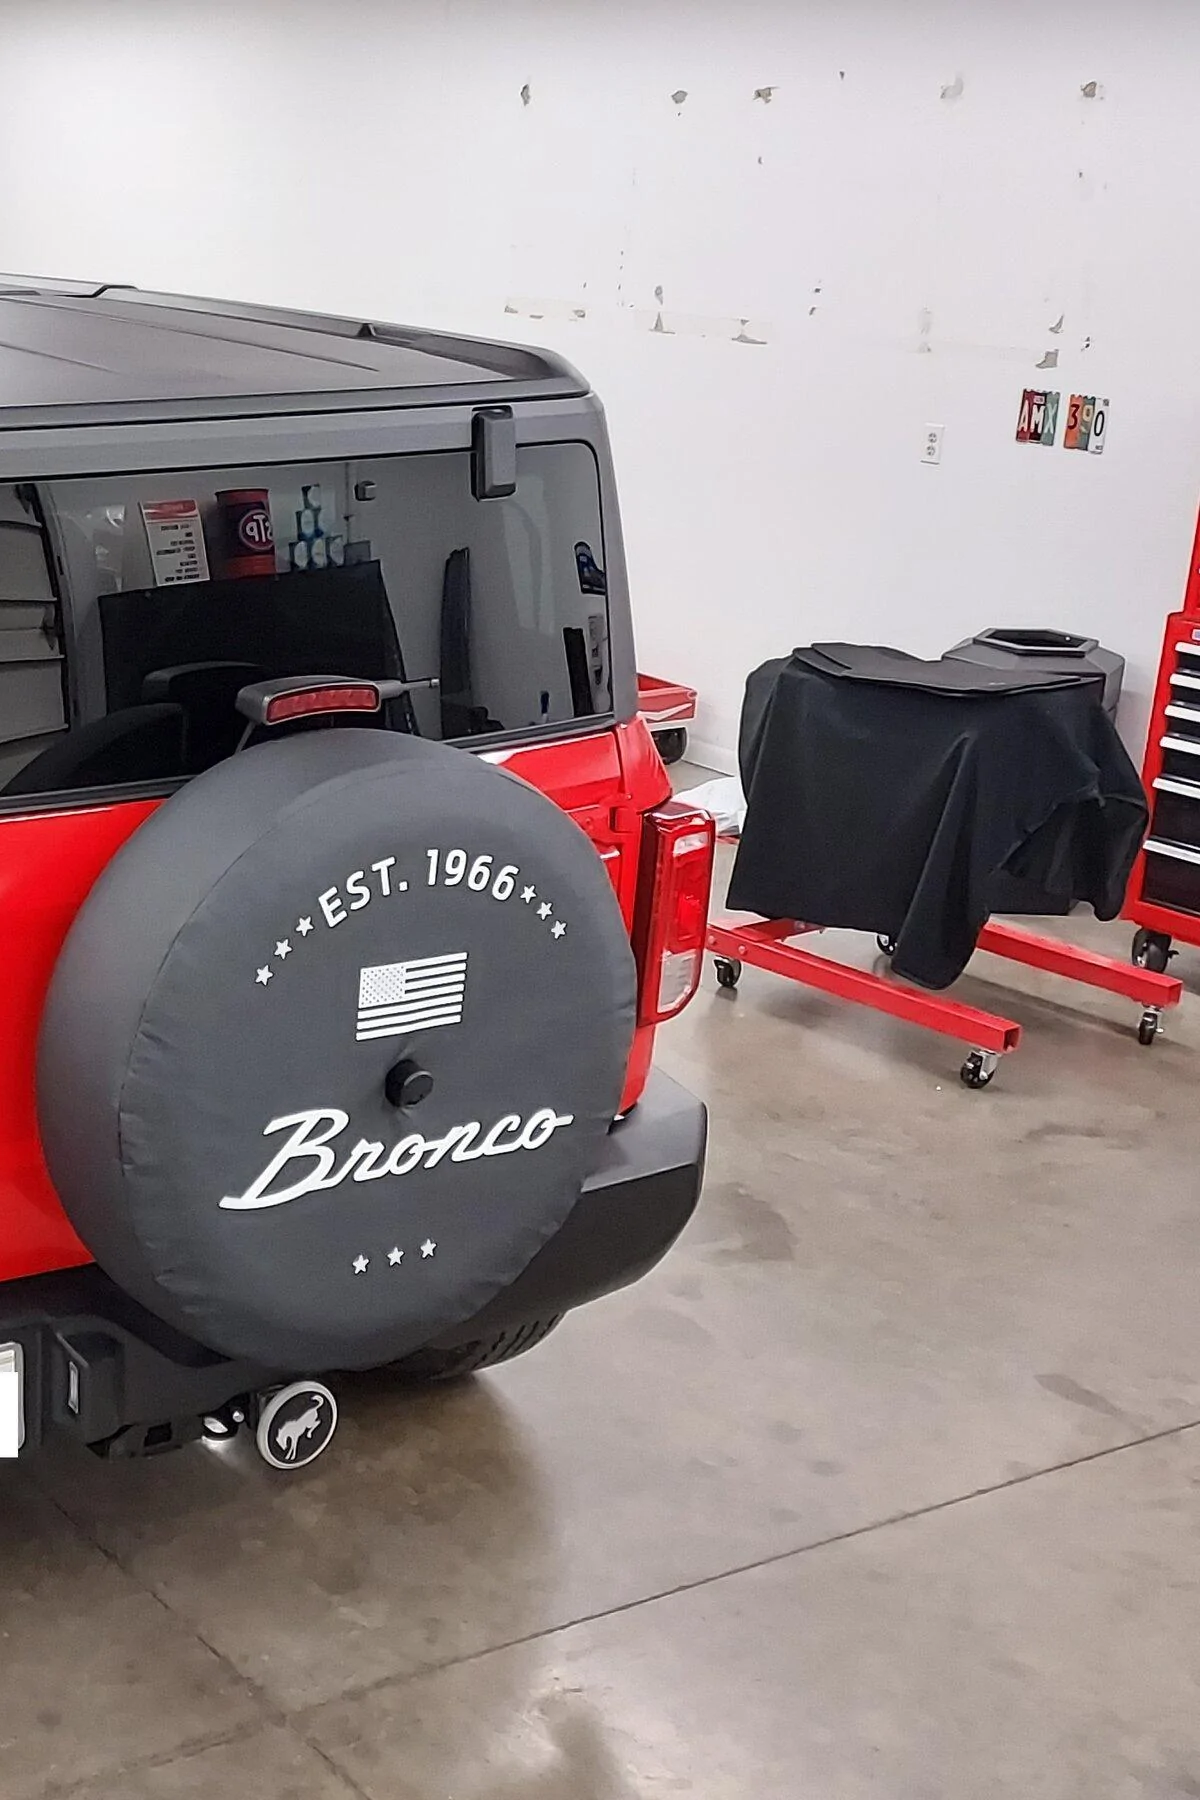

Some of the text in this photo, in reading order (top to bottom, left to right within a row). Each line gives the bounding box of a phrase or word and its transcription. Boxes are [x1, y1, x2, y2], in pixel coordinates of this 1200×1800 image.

[1017, 399, 1105, 437] AMX 390
[318, 848, 519, 928] EST. 1966
[218, 1108, 574, 1210] Bronco
